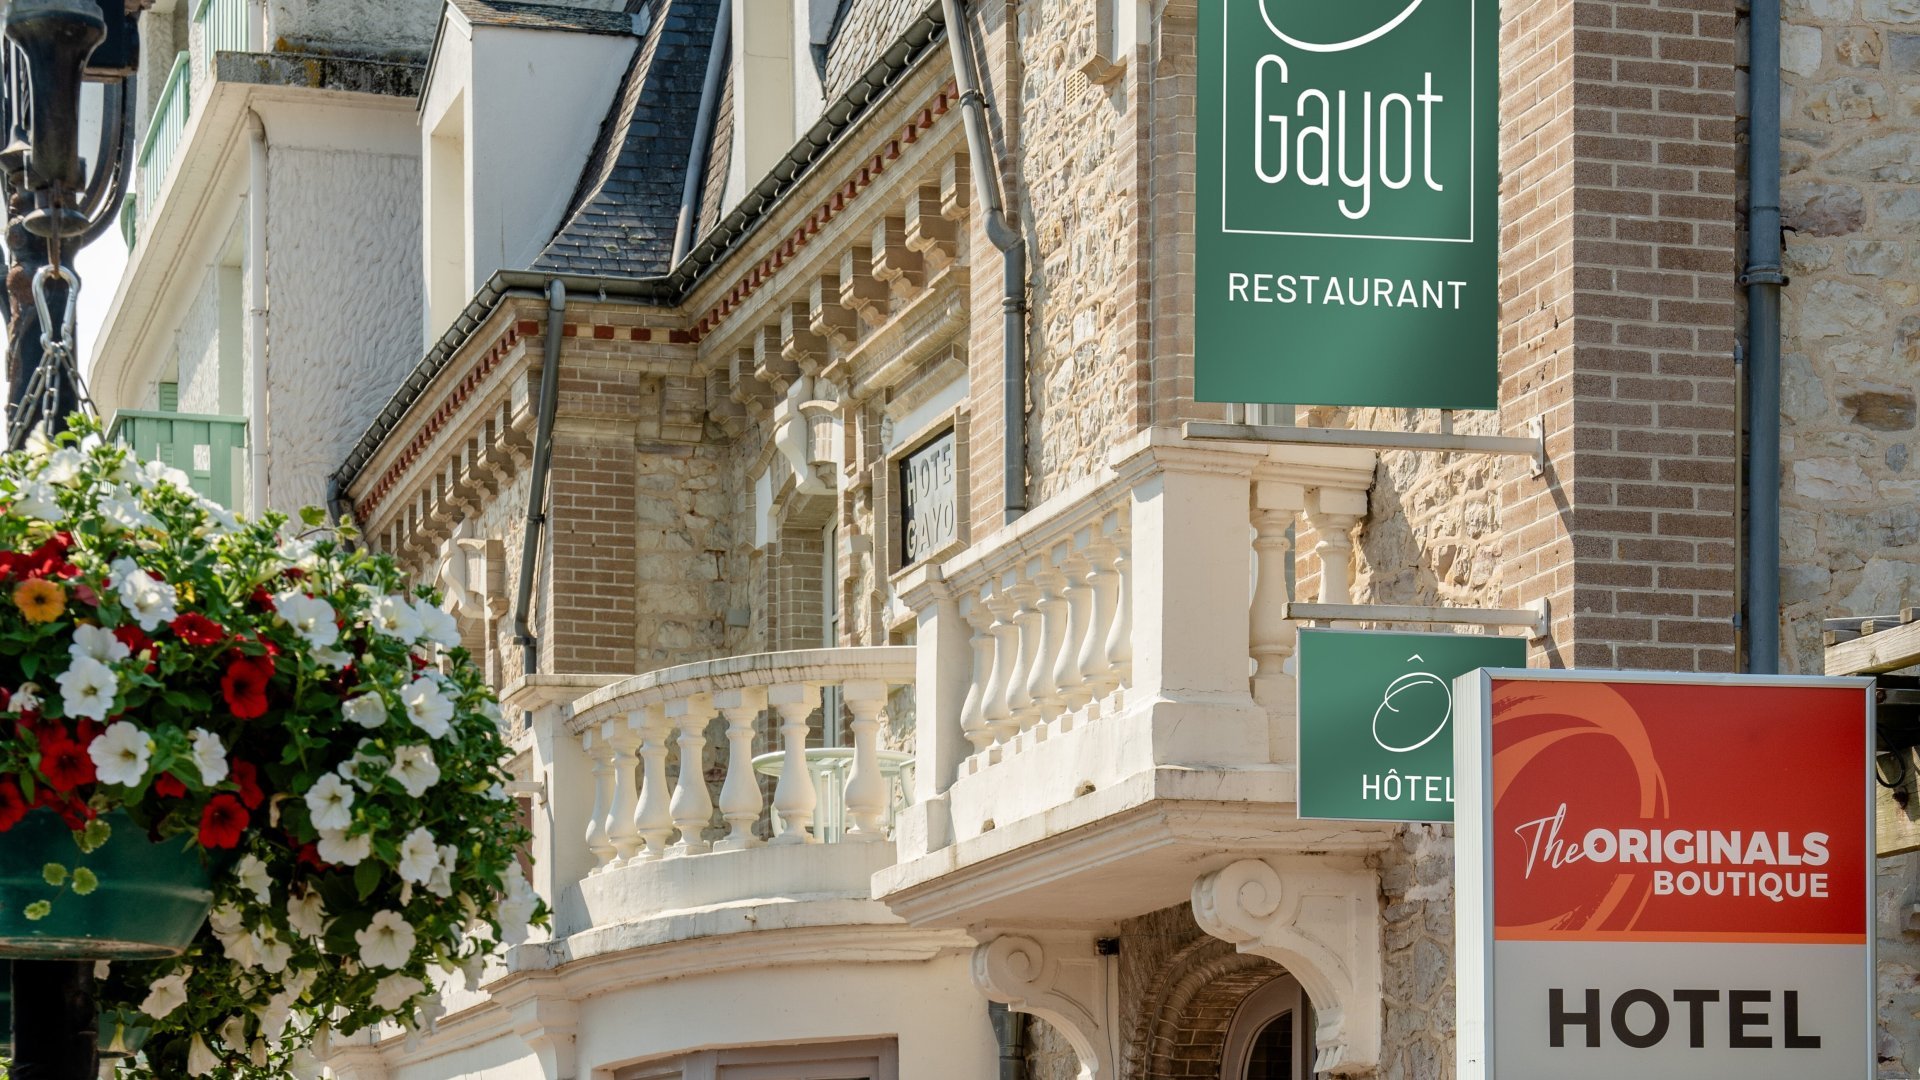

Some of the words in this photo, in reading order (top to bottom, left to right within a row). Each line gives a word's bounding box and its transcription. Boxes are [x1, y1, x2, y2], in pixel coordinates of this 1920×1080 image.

[1254, 54, 1443, 220] Gayot
[1228, 272, 1467, 310] RESTAURANT
[906, 443, 952, 507] HOTE
[906, 500, 954, 559] GAYO
[1362, 768, 1455, 803] HÔTEL
[1514, 803, 1585, 879] The
[1583, 828, 1830, 866] ORIGINALS
[1653, 870, 1829, 902] BOUTIQUE
[1548, 988, 1822, 1049] HOTEL
